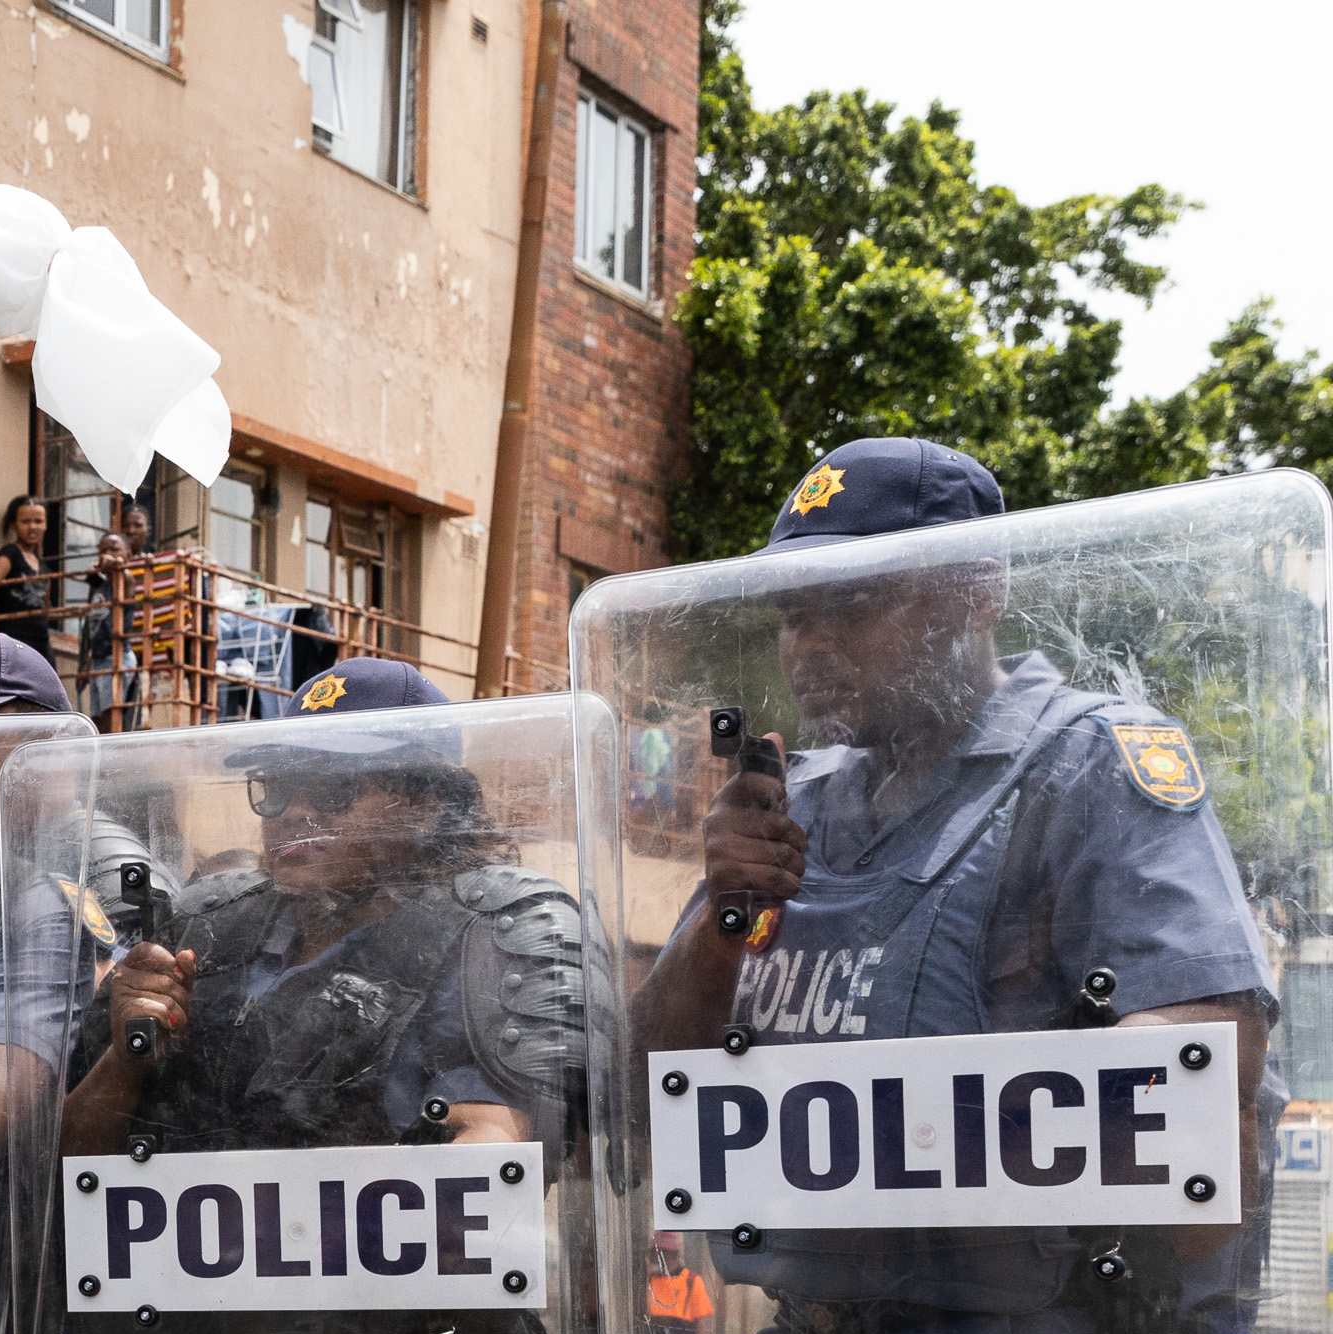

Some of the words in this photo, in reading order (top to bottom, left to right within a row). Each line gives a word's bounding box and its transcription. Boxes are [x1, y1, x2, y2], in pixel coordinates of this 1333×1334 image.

[1119, 730, 1182, 745] POLICE
[730, 947, 883, 1035] POLICE
[696, 1066, 1170, 1193] POLICE
[105, 1176, 493, 1280] POLICE
